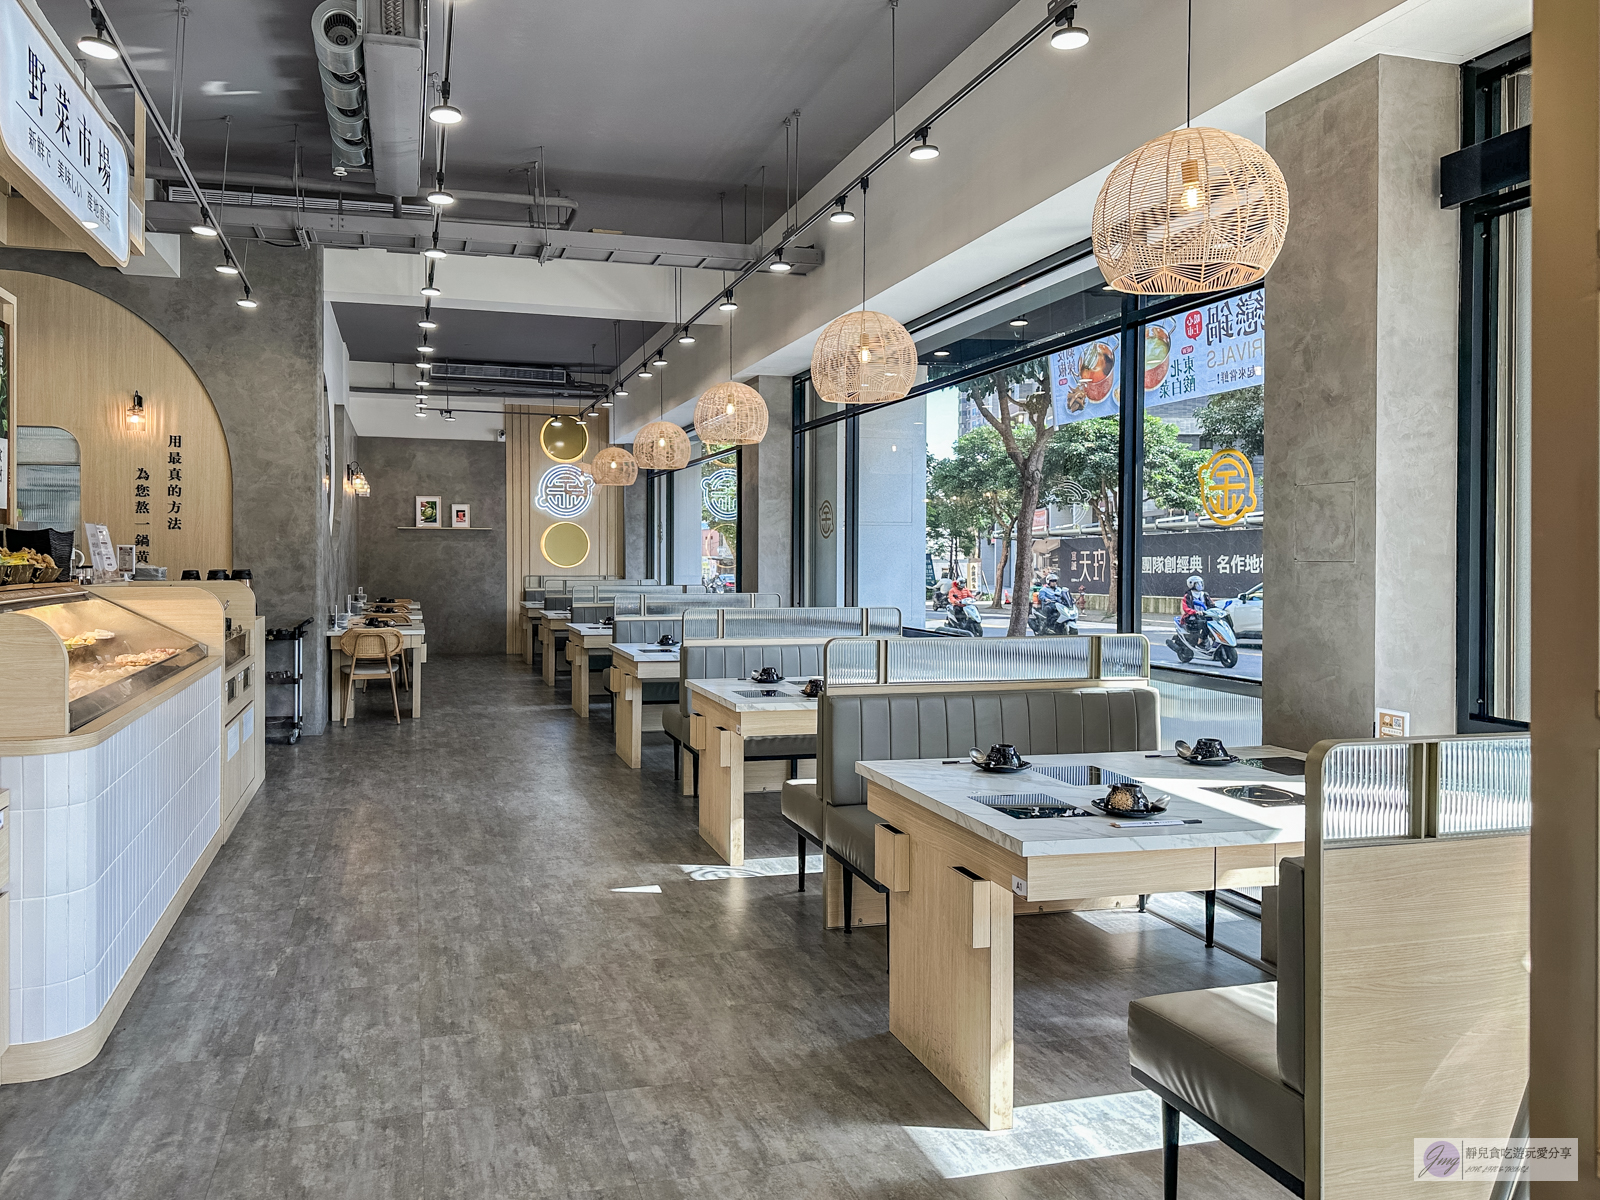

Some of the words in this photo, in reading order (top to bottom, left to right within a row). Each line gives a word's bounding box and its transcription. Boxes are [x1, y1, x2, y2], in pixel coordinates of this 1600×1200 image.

[28, 45, 112, 194] 野菜市場
[28, 127, 52, 168] 新鮮で
[57, 159, 83, 198] 美味しい
[167, 435, 182, 531] 用最真的方法
[1217, 554, 1264, 574] 名作地
